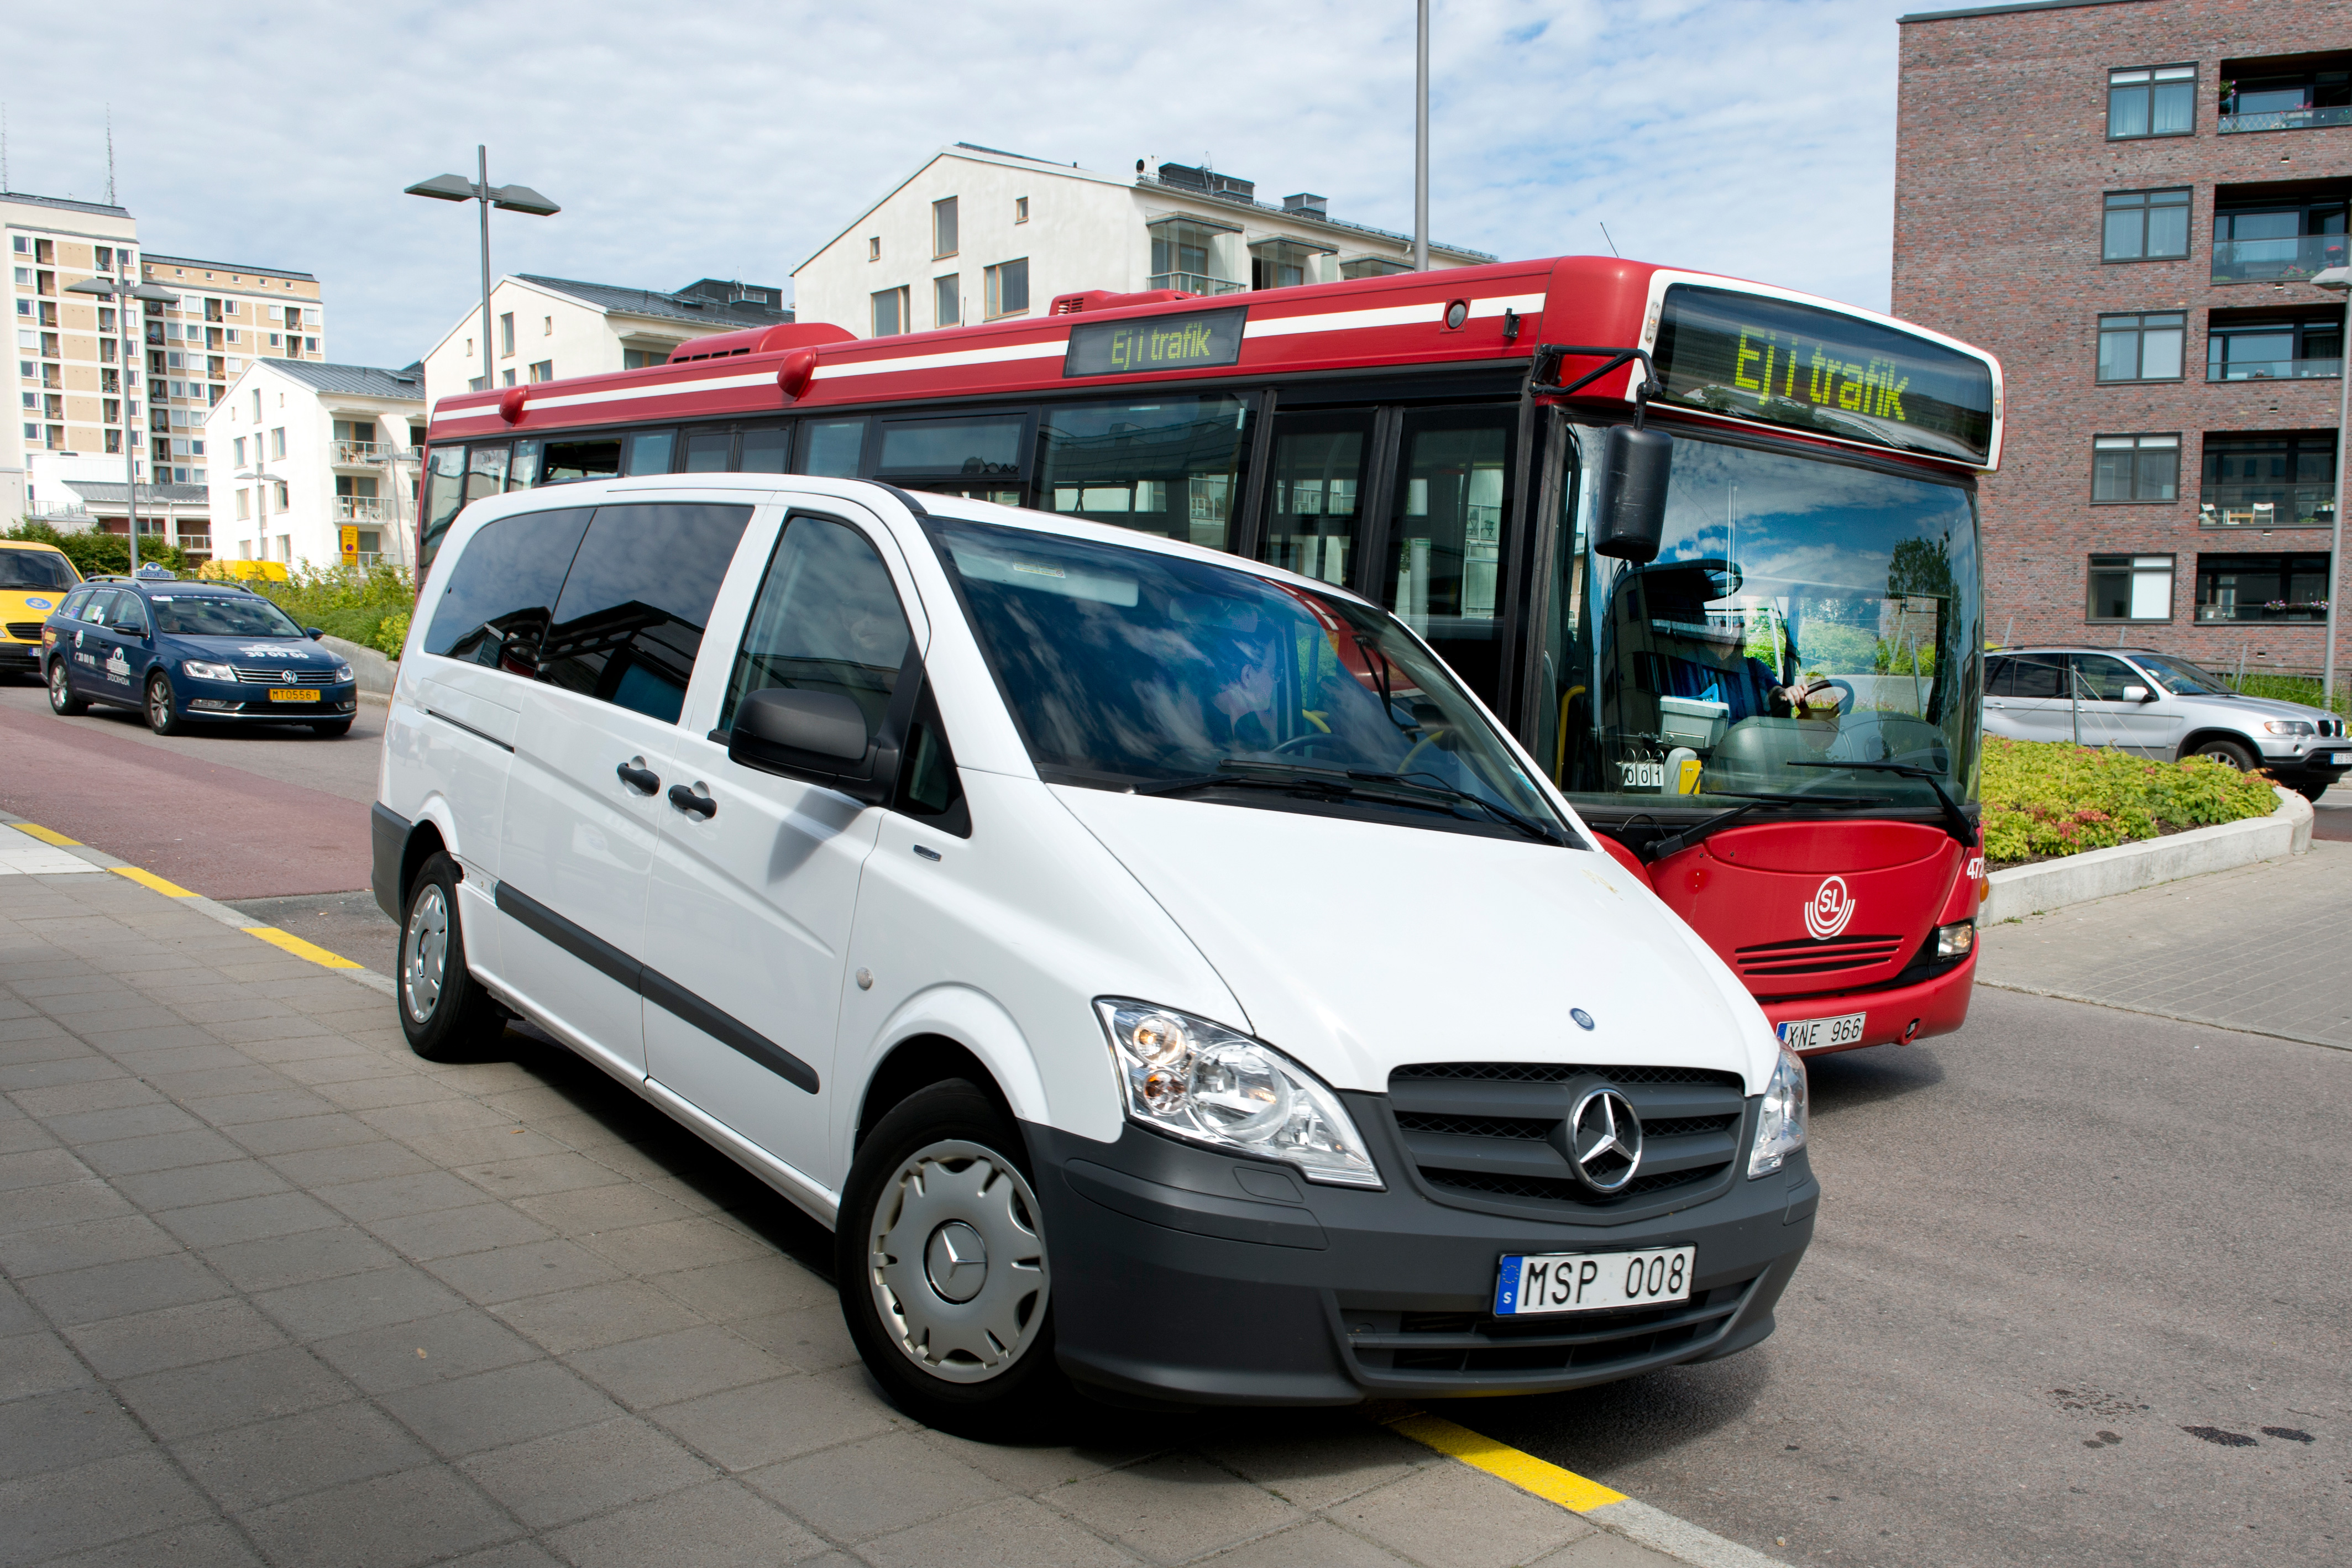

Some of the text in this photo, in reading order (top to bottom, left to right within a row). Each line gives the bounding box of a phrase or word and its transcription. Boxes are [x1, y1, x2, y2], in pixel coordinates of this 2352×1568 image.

[1112, 322, 1211, 370] Ej i trafik
[1735, 324, 1909, 421] Ej i trafik
[1819, 889, 1840, 913] SL
[1788, 1018, 1861, 1047] XNE 966
[1503, 1253, 1684, 1307] S MSP 008
